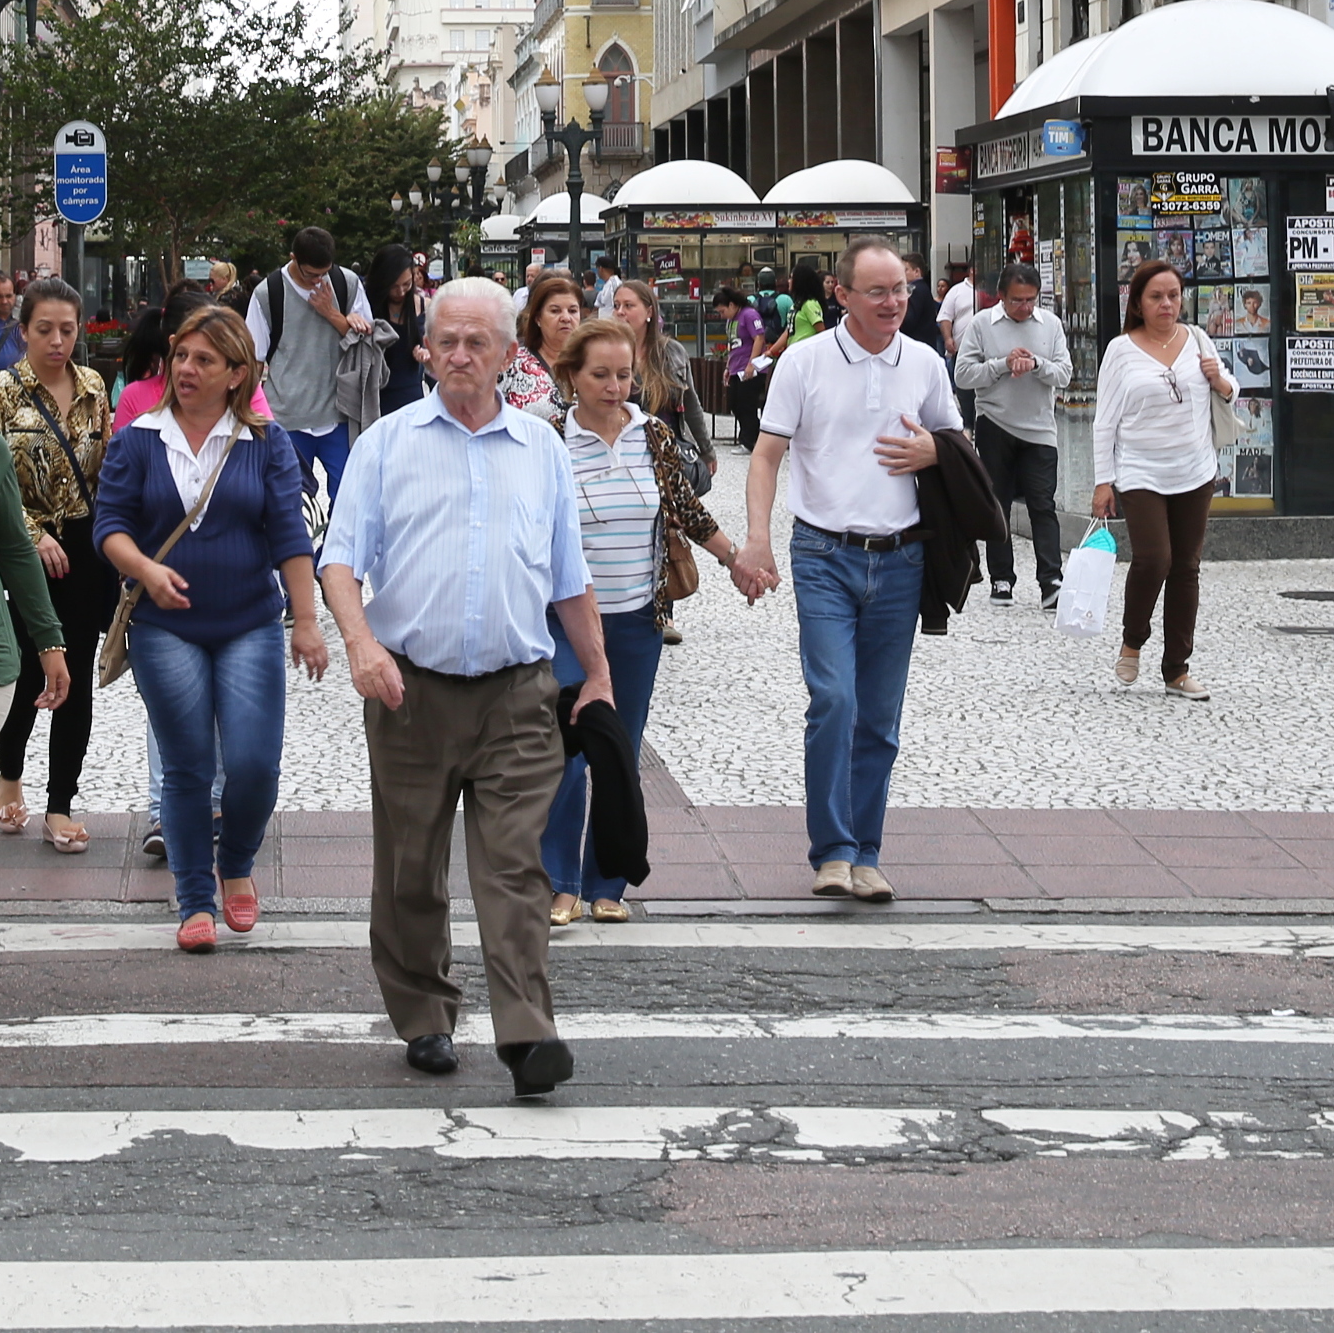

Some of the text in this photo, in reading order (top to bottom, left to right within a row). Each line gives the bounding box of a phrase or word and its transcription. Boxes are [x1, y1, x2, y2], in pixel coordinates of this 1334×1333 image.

[1141, 116, 1258, 154] BANCA
[70, 164, 91, 174] Área
[57, 176, 105, 185] monitorada
[1176, 172, 1215, 183] GRUPO
[73, 188, 88, 196] por
[1181, 183, 1220, 195] GARRA
[62, 197, 99, 205] câmeras
[715, 212, 775, 222] Sukinho da XV
[1289, 237, 1318, 259] PM
[1290, 357, 1324, 366] PREFEITURA
[1324, 358, 1333, 366] DE
[1292, 369, 1317, 379] DOCÊNCIA
